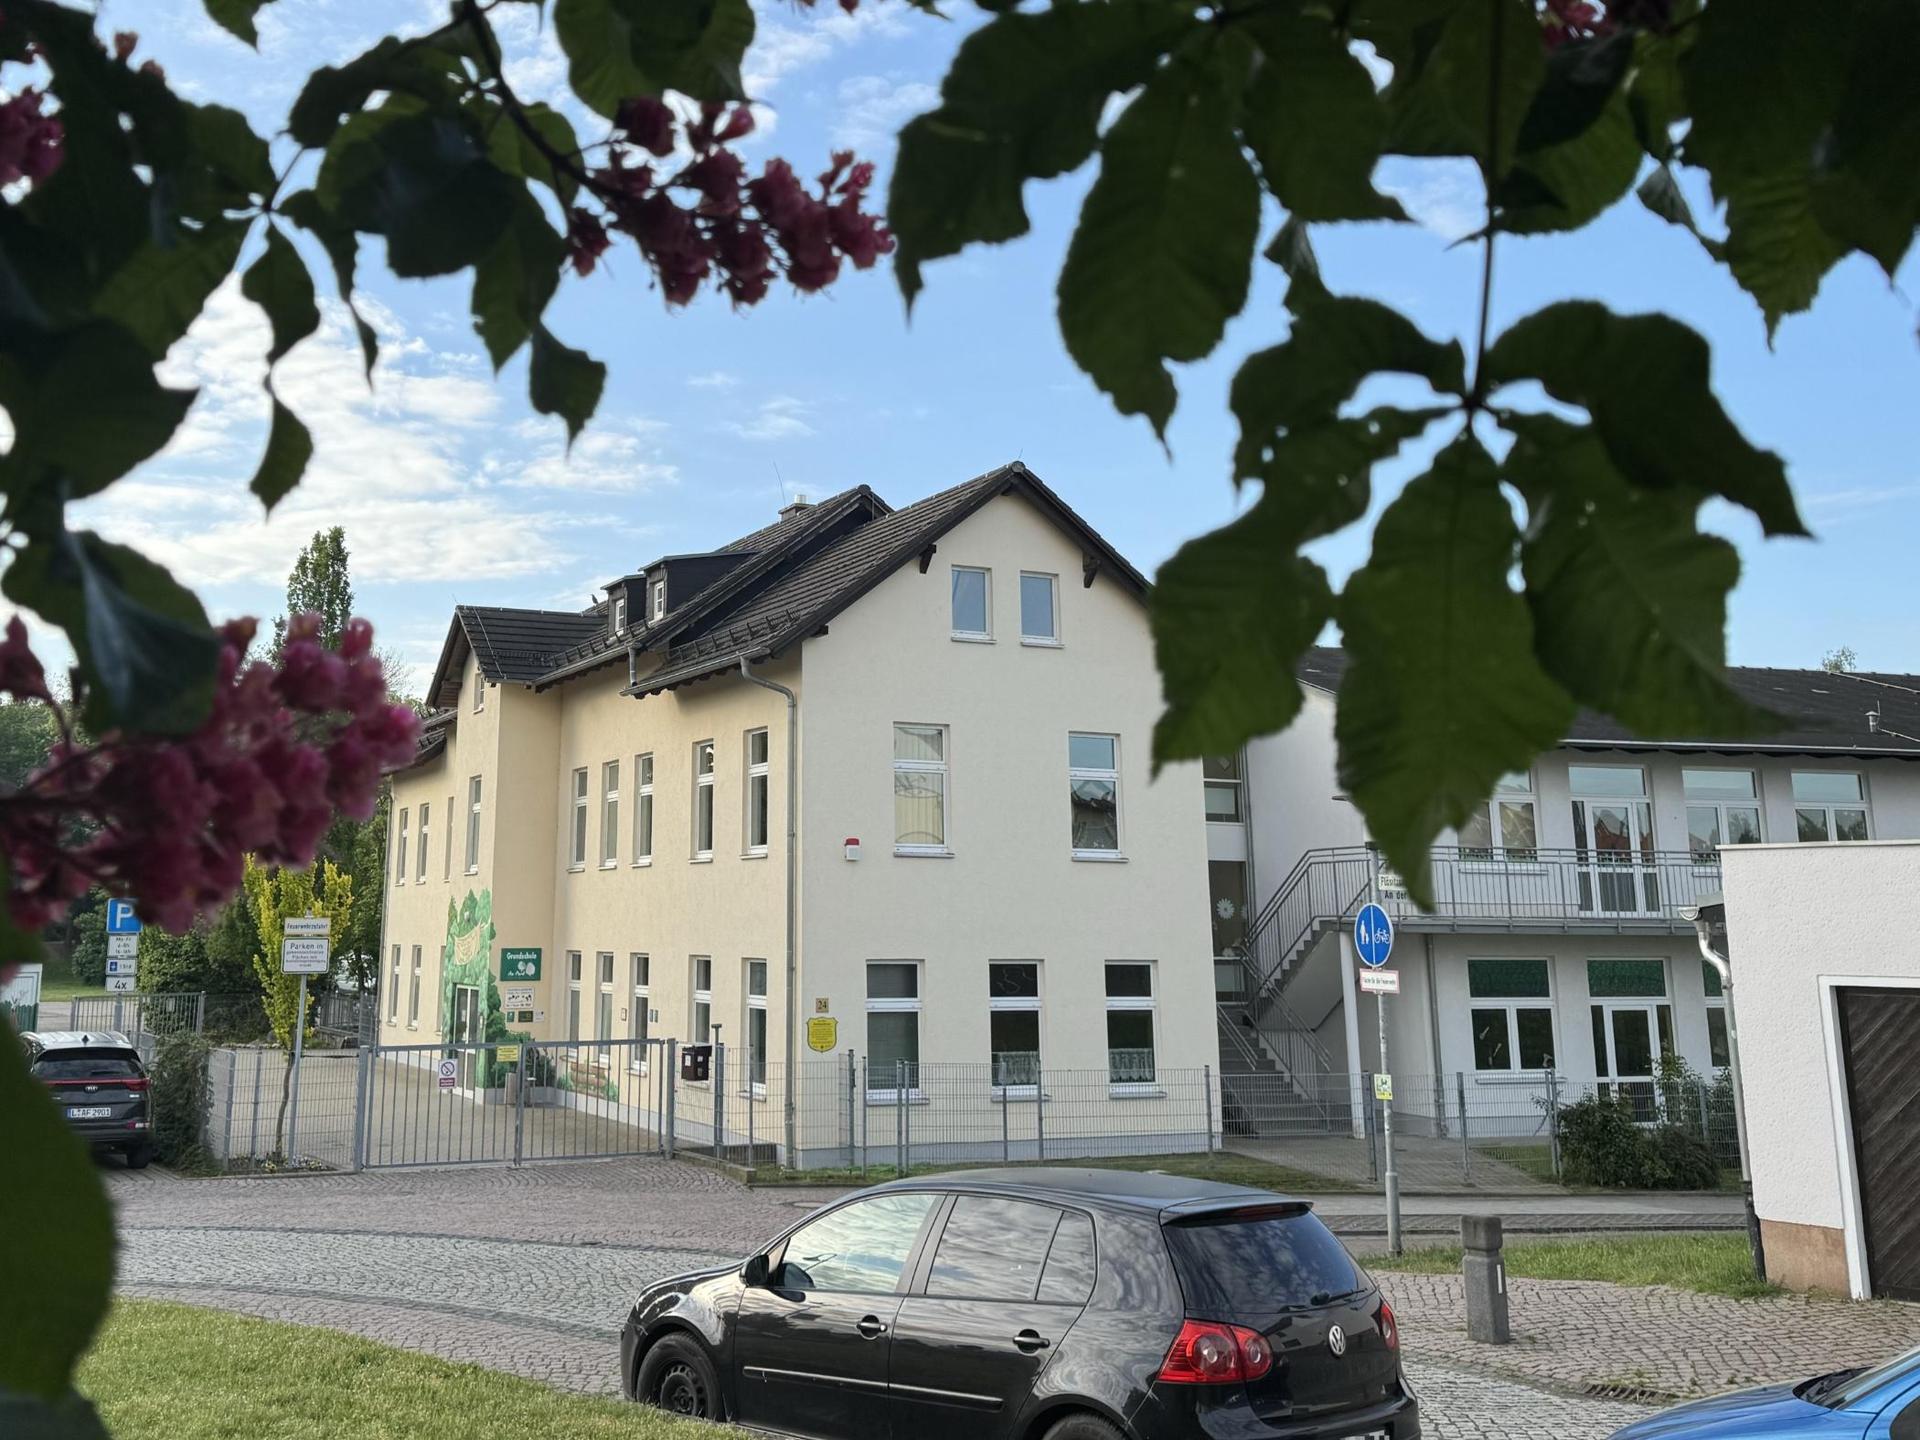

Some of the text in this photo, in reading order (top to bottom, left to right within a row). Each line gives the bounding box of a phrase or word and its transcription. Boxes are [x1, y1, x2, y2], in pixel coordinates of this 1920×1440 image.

[116, 903, 134, 929] P
[506, 951, 538, 960] Grundschule
[114, 980, 128, 990] 4x
[818, 1000, 827, 1010] 24
